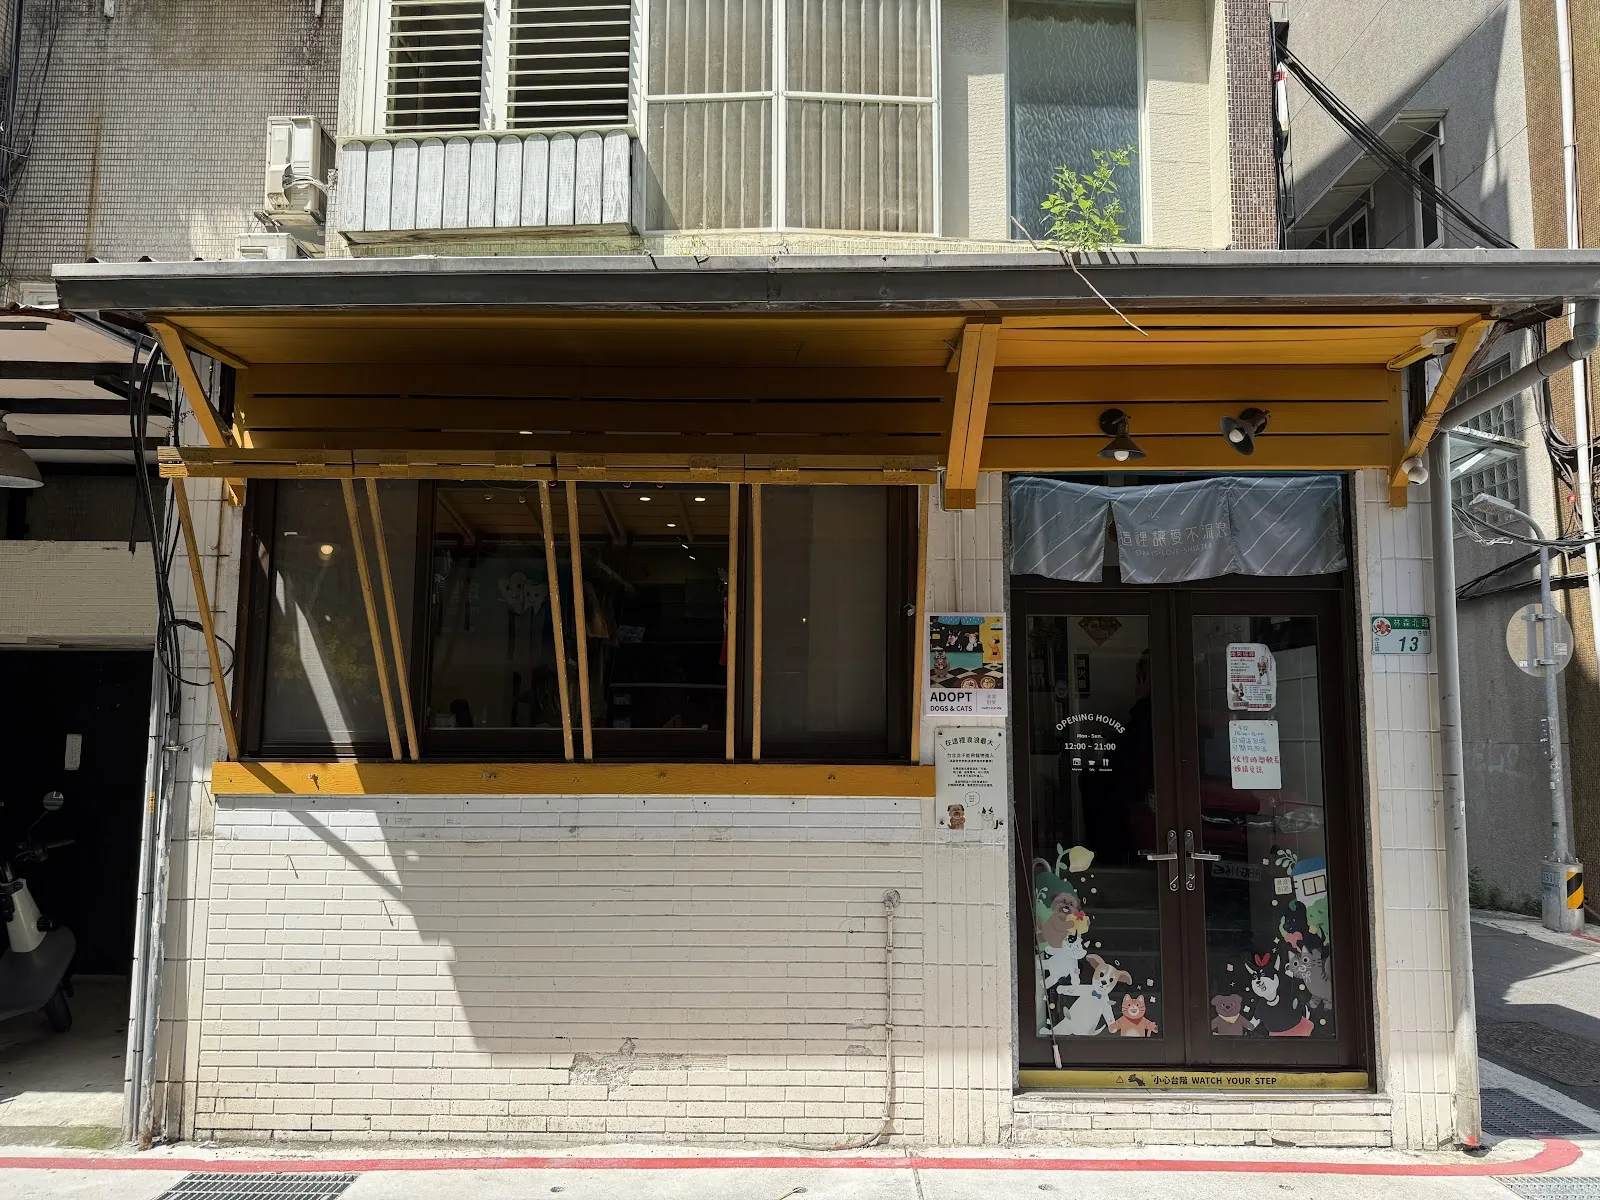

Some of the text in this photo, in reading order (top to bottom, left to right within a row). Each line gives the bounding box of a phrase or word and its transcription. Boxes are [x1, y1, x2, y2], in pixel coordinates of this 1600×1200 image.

[1393, 618, 1429, 628] 林森北路
[1399, 636, 1419, 652] 13
[930, 692, 973, 702] ADOPT
[1056, 713, 1126, 734] OPENING HOURS
[1064, 742, 1086, 750] 12:00
[1153, 1075, 1277, 1086] 小心台階 WATCH YOUR STEP
